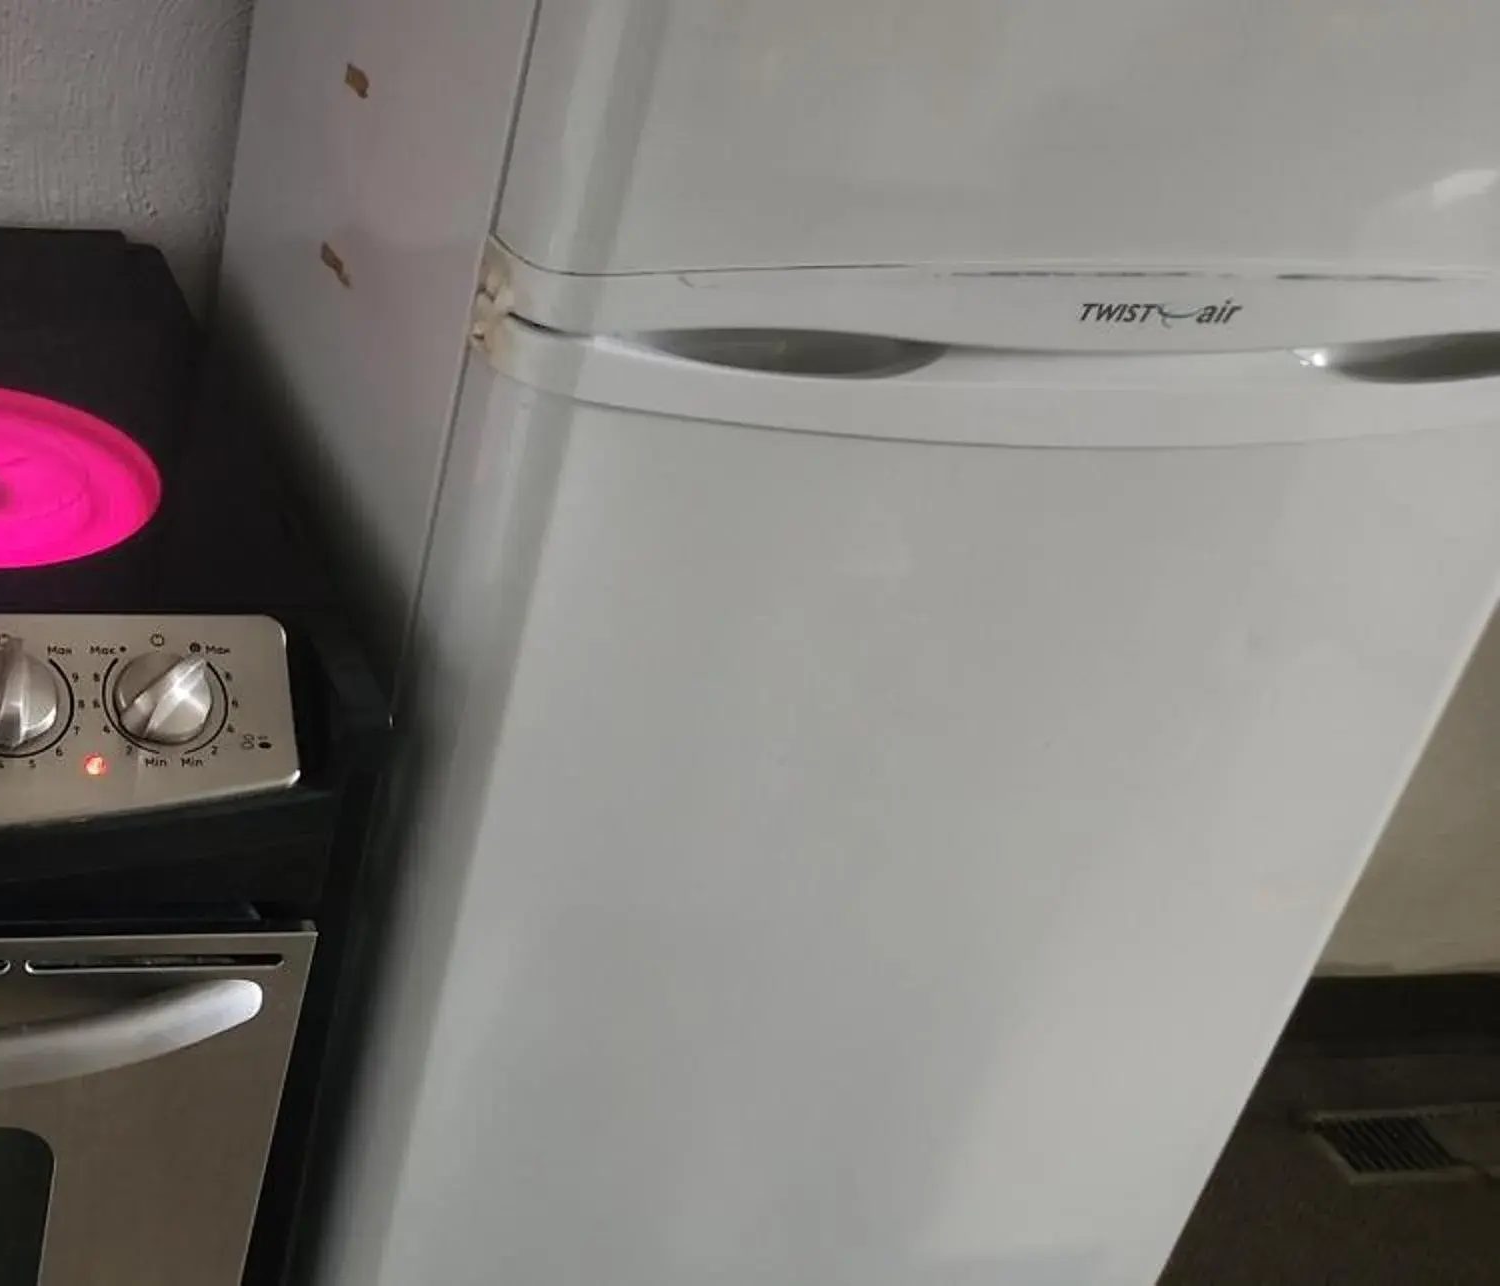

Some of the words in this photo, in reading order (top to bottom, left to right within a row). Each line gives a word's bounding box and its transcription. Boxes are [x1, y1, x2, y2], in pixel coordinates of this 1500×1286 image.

[1080, 303, 1156, 322] TWIST
[1196, 299, 1243, 324] air
[47, 645, 72, 655] Max
[90, 645, 116, 655] Max
[205, 645, 231, 655] Max
[145, 758, 167, 767] Min
[181, 758, 203, 767] Min
